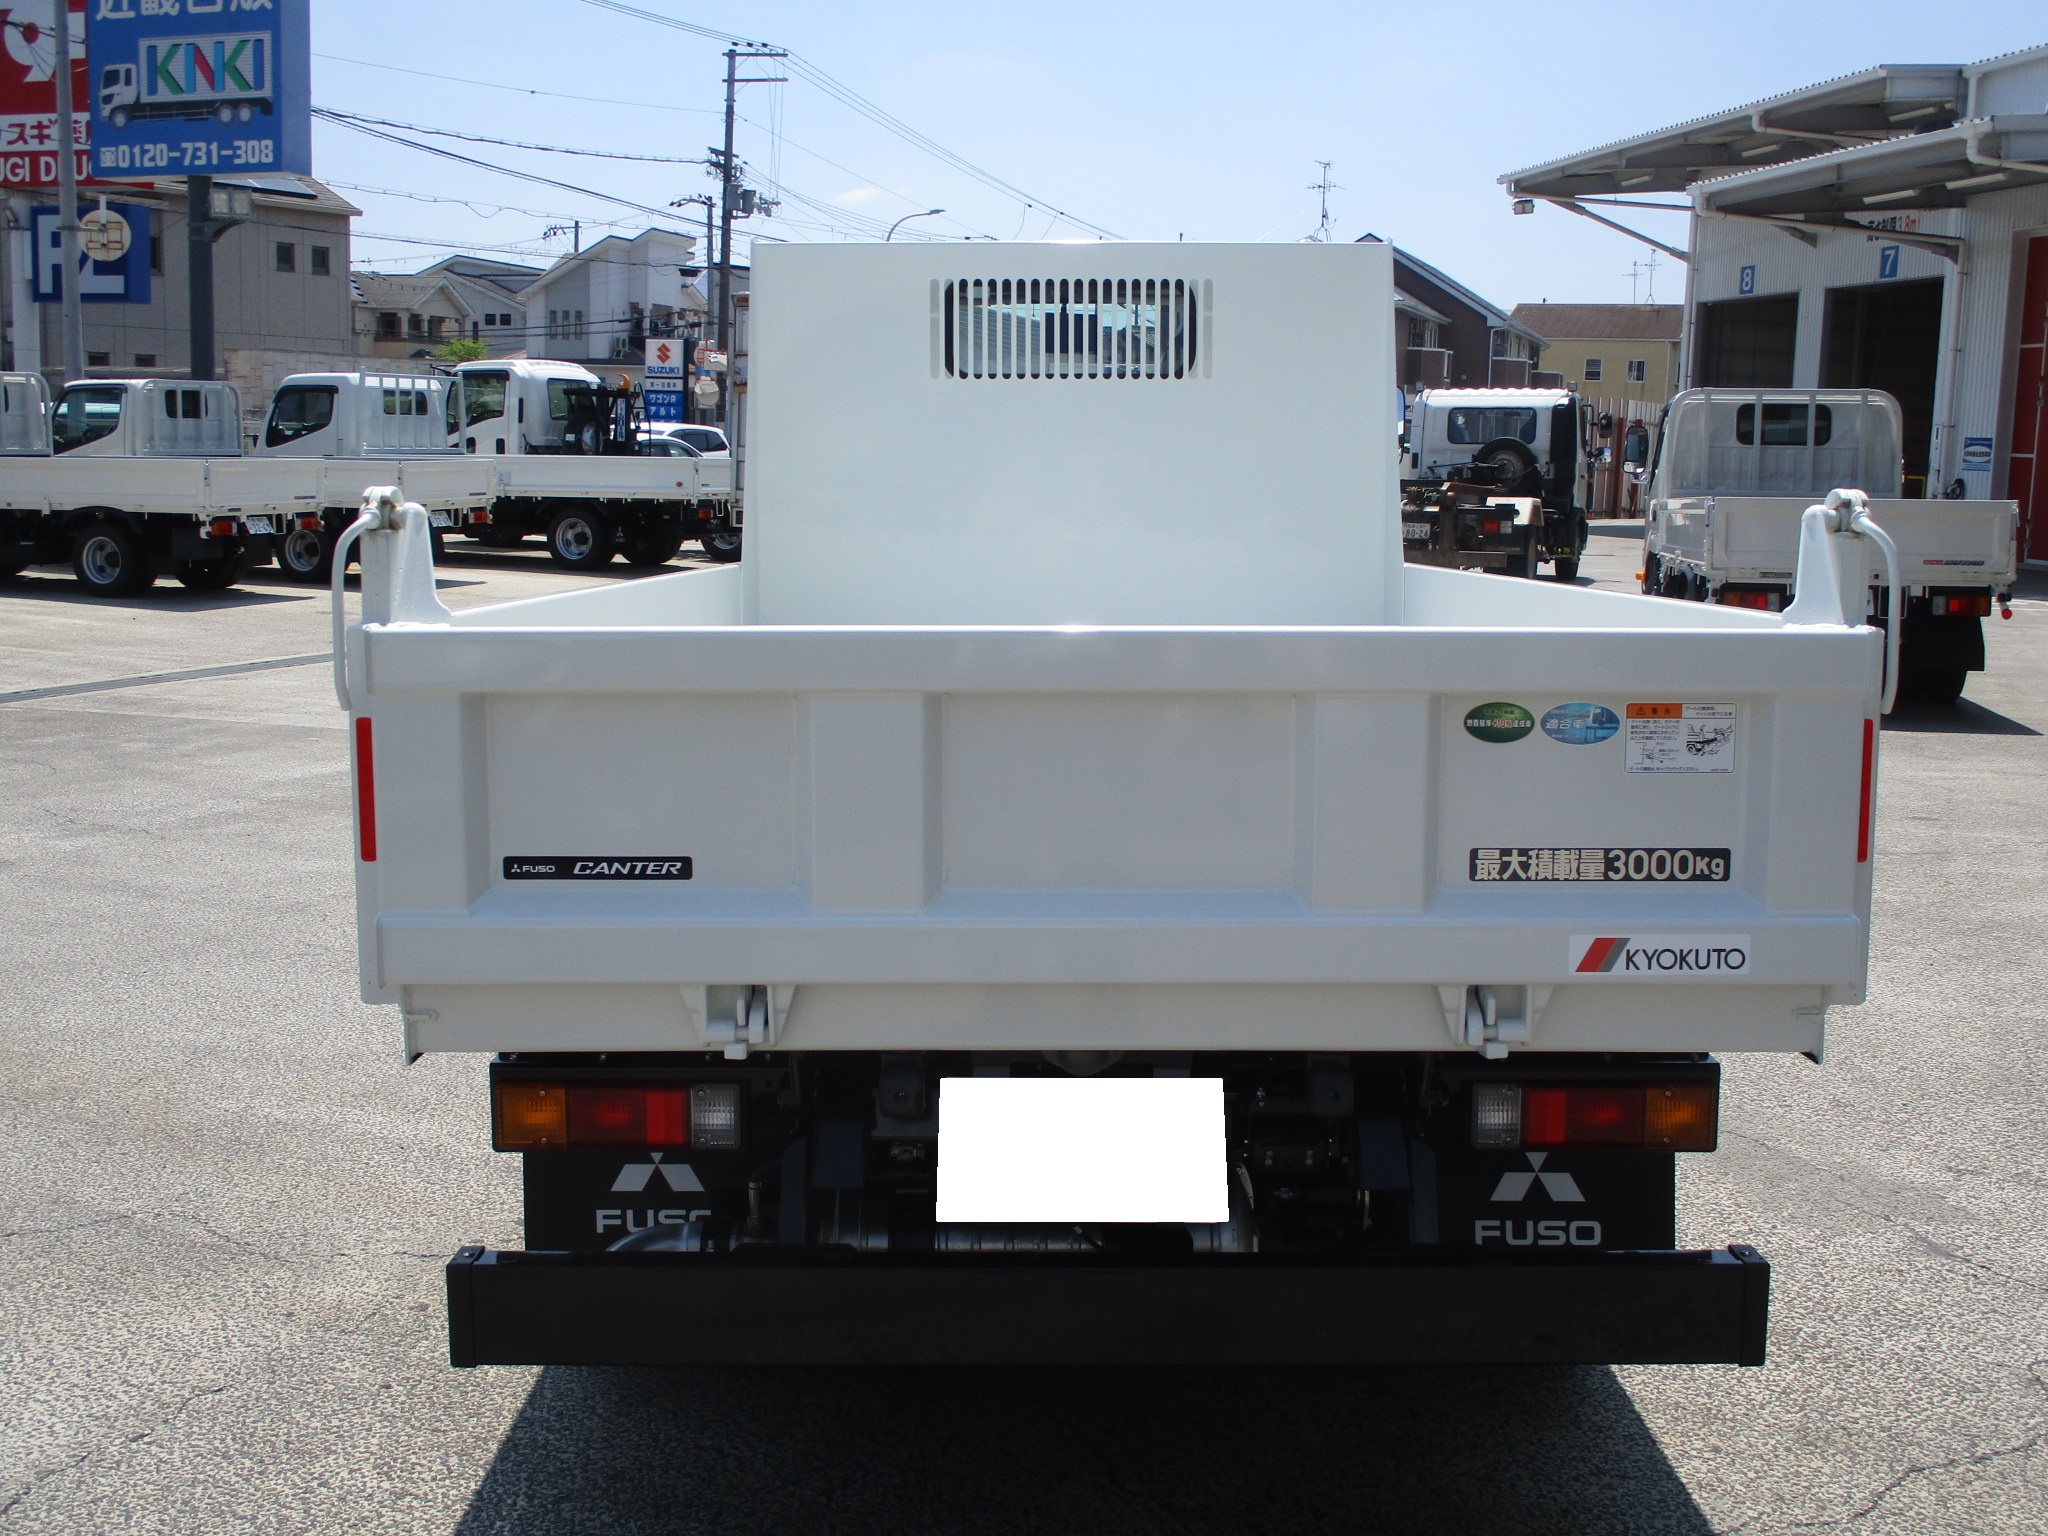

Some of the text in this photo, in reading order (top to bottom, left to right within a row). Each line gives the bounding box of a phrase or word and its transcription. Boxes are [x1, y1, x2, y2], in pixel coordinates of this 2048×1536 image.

[117, 140, 274, 168] 0120-731-308
[1884, 249, 1896, 275] 7
[1742, 270, 1752, 290] 8
[646, 366, 680, 374] SUZUKI
[649, 394, 677, 404] ワゴンR
[649, 406, 676, 416] アルト
[573, 862, 682, 875] CANTER
[1626, 948, 1745, 970] KYOKUTO
[1474, 1220, 1602, 1246] FUSO
